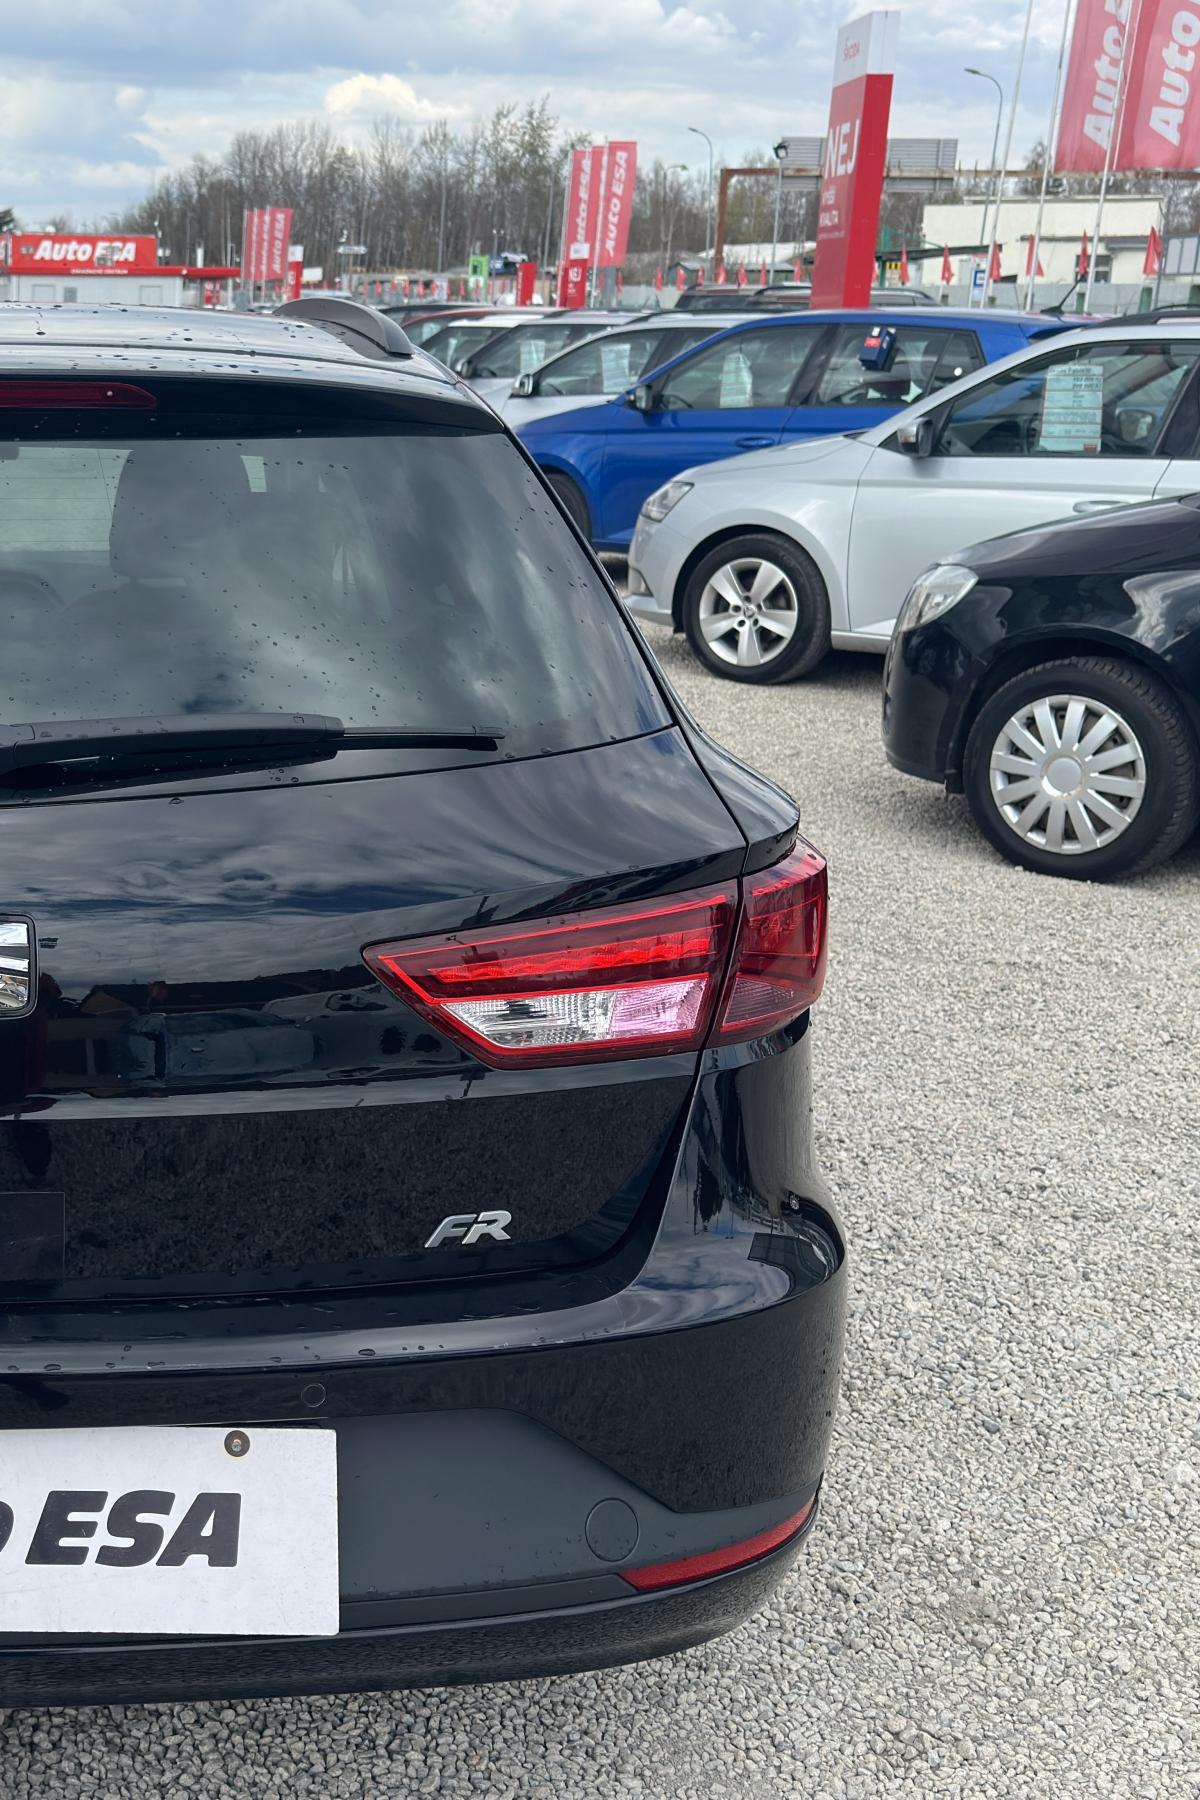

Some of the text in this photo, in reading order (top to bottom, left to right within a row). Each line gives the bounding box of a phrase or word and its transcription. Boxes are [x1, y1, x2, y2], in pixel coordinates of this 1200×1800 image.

[1150, 10, 1200, 147] Auto
[825, 119, 860, 180] NEJ
[605, 151, 629, 258] Auto ESA
[33, 239, 93, 262] Auto
[424, 1210, 513, 1248] FR
[25, 1489, 242, 1568] ESA
